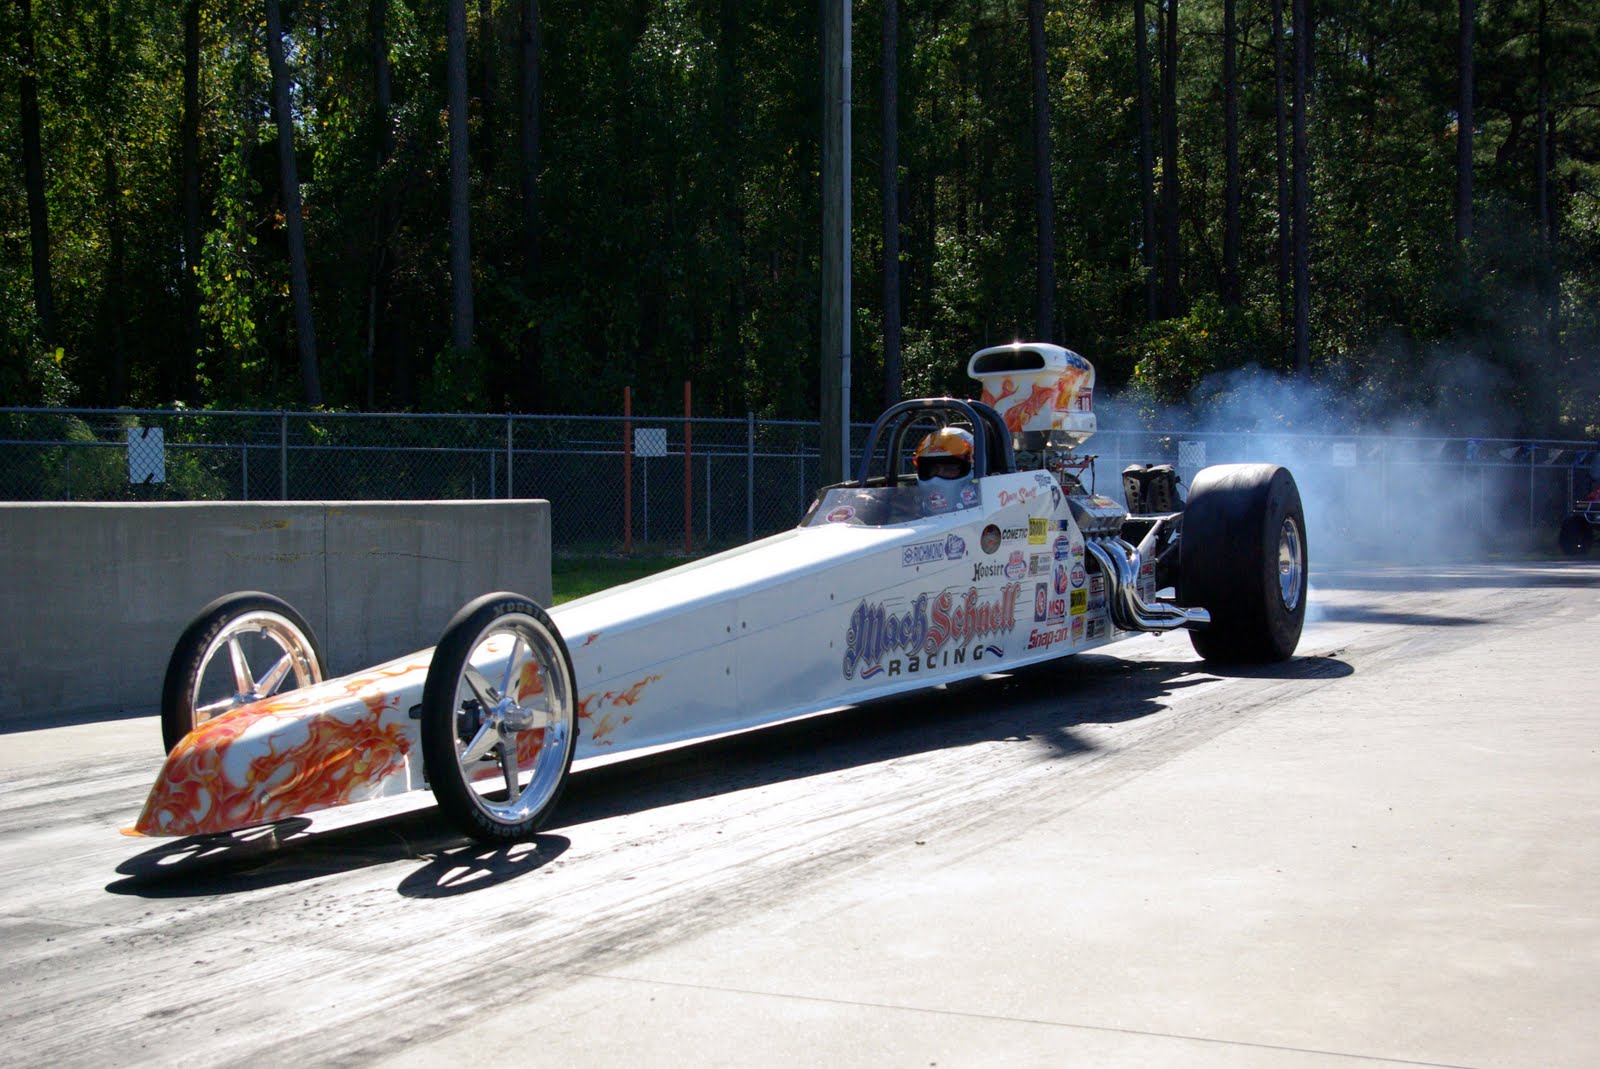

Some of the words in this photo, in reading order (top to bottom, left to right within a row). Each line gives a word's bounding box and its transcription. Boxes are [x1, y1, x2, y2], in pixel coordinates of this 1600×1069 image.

[1002, 528, 1028, 540] COMETIC
[913, 542, 943, 562] RICHMOND
[972, 561, 1004, 581] Hoosier
[1049, 599, 1065, 616] MSD
[843, 592, 928, 680] Mach
[923, 582, 1021, 655] Schnell
[1028, 628, 1068, 650] Snap-on
